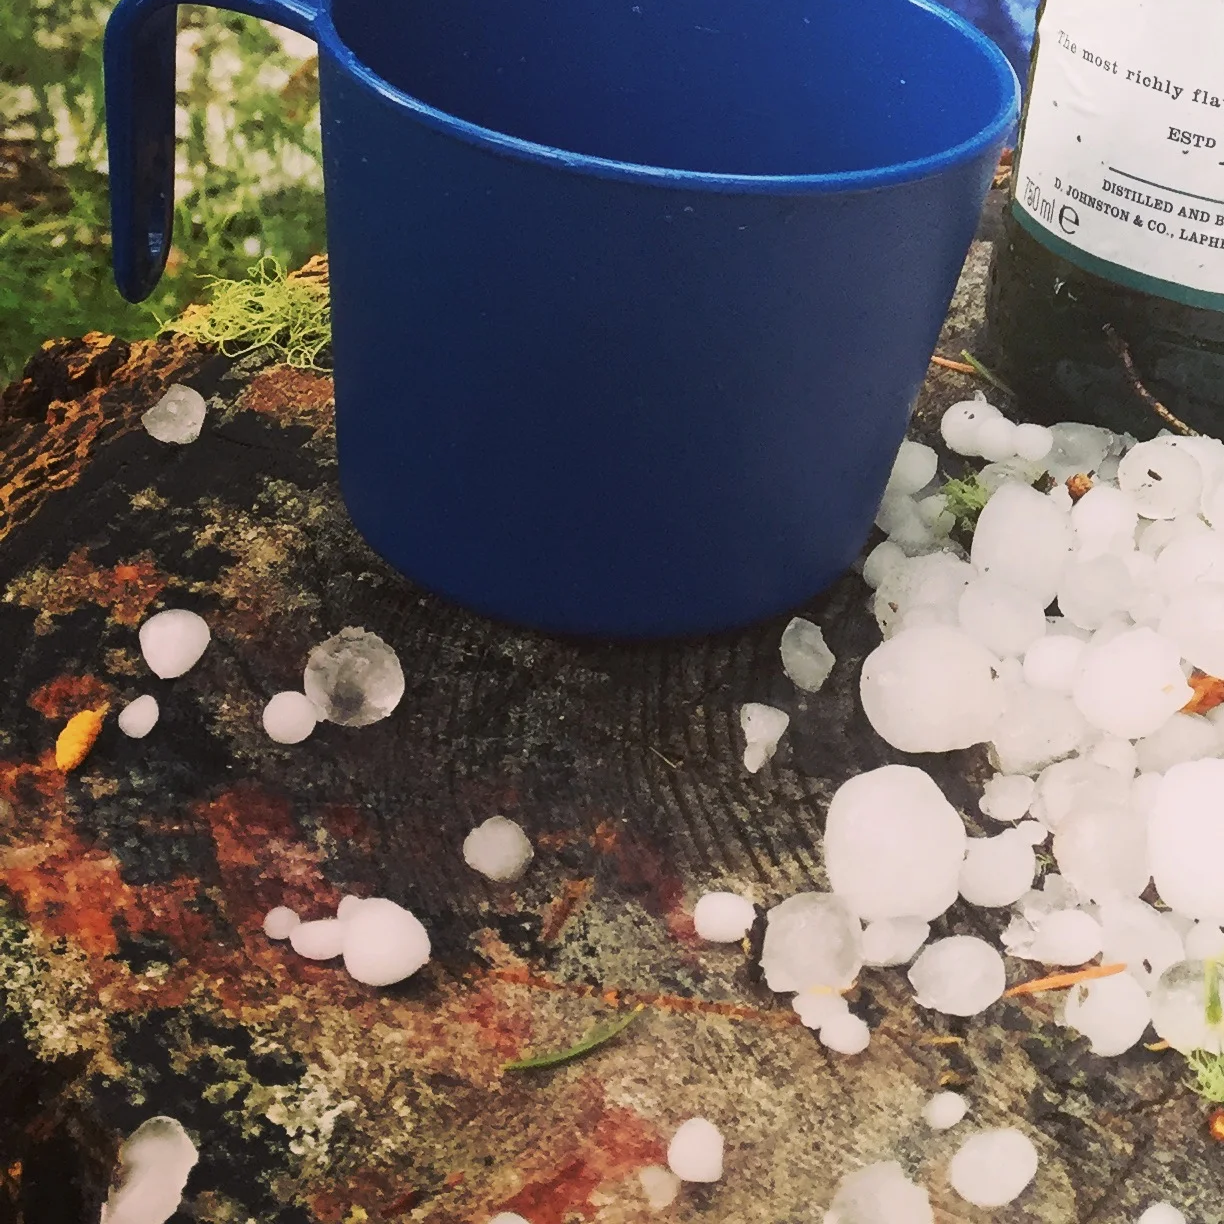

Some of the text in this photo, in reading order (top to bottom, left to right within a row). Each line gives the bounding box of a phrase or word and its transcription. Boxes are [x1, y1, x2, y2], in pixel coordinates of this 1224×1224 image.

[1057, 29, 1077, 54] The
[1082, 48, 1118, 75] most
[1125, 68, 1185, 100] richly
[1167, 126, 1217, 149] ESTD
[1053, 176, 1063, 192] D.
[1065, 185, 1130, 223] JOHNSTON
[1132, 214, 1144, 228] &
[1147, 219, 1175, 239] CO.,
[1101, 178, 1174, 214] DISTILLED
[1177, 206, 1211, 224] AND
